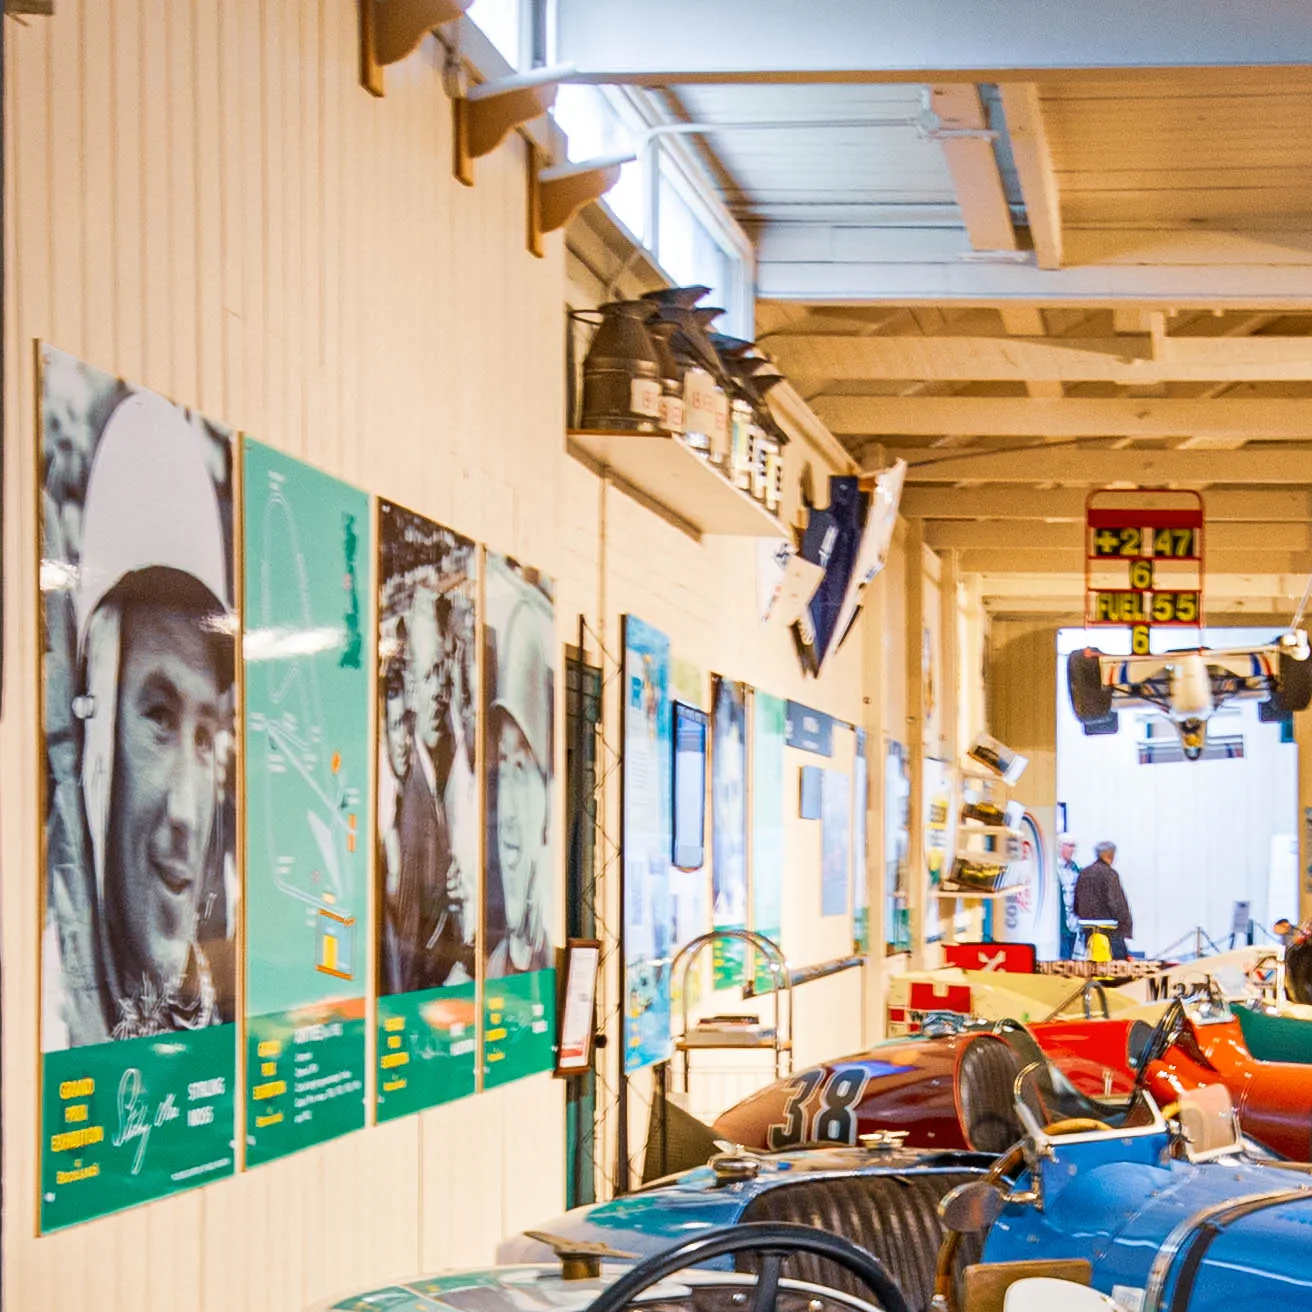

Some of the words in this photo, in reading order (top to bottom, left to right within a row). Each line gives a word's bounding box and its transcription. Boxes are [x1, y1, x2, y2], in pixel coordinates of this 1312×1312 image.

[1155, 528, 1193, 556] 47
[1132, 560, 1151, 589] 6
[1097, 593, 1144, 622] FUEL
[1153, 593, 1197, 622] 55
[1133, 625, 1150, 654] 6
[768, 1067, 871, 1153] 38
